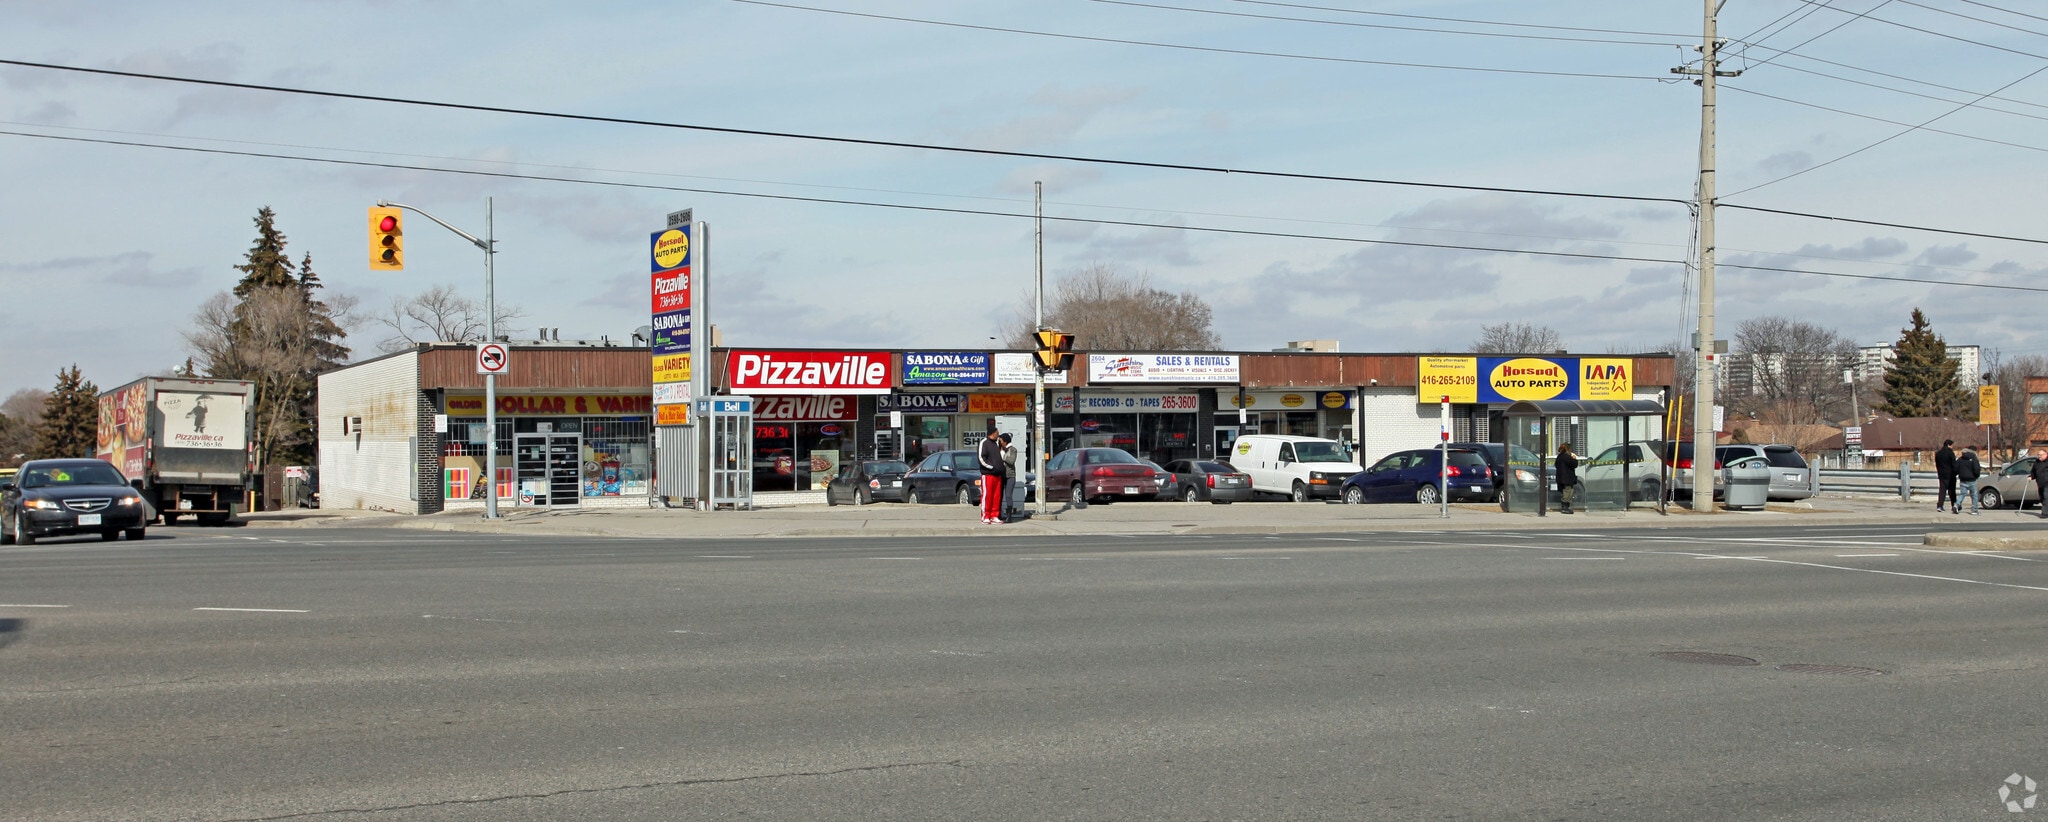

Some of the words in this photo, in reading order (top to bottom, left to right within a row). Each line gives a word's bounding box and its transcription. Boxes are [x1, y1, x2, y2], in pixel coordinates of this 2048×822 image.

[656, 249, 670, 258] AUTO
[670, 245, 687, 255] PARTS
[654, 273, 689, 295] Pizzaville
[654, 314, 683, 330] SABONA
[664, 357, 690, 371] VARIETY
[907, 355, 962, 365] SABONA
[970, 356, 984, 364] Gift
[1105, 357, 1143, 374] Sunshine
[1156, 356, 1182, 366] SALES
[1185, 357, 1190, 366] &
[1194, 356, 1230, 366] RENTALS
[736, 354, 885, 385] Pizzaville
[909, 366, 946, 378] Amazon
[1585, 365, 1626, 380] IAPA
[1494, 380, 1525, 388] AUTO
[1529, 380, 1566, 388] PARTS
[449, 401, 482, 409] GILDER
[575, 397, 588, 412] &
[724, 402, 740, 411] Bell
[753, 395, 845, 418] zzaville
[879, 395, 947, 408] SBONA
[1089, 398, 1120, 407] RECORDS
[1125, 398, 1134, 407] CD
[1140, 398, 1160, 407] TAPES
[1161, 396, 1197, 409] 265-3600
[560, 422, 578, 430] OPEN
[755, 427, 775, 438] 736
